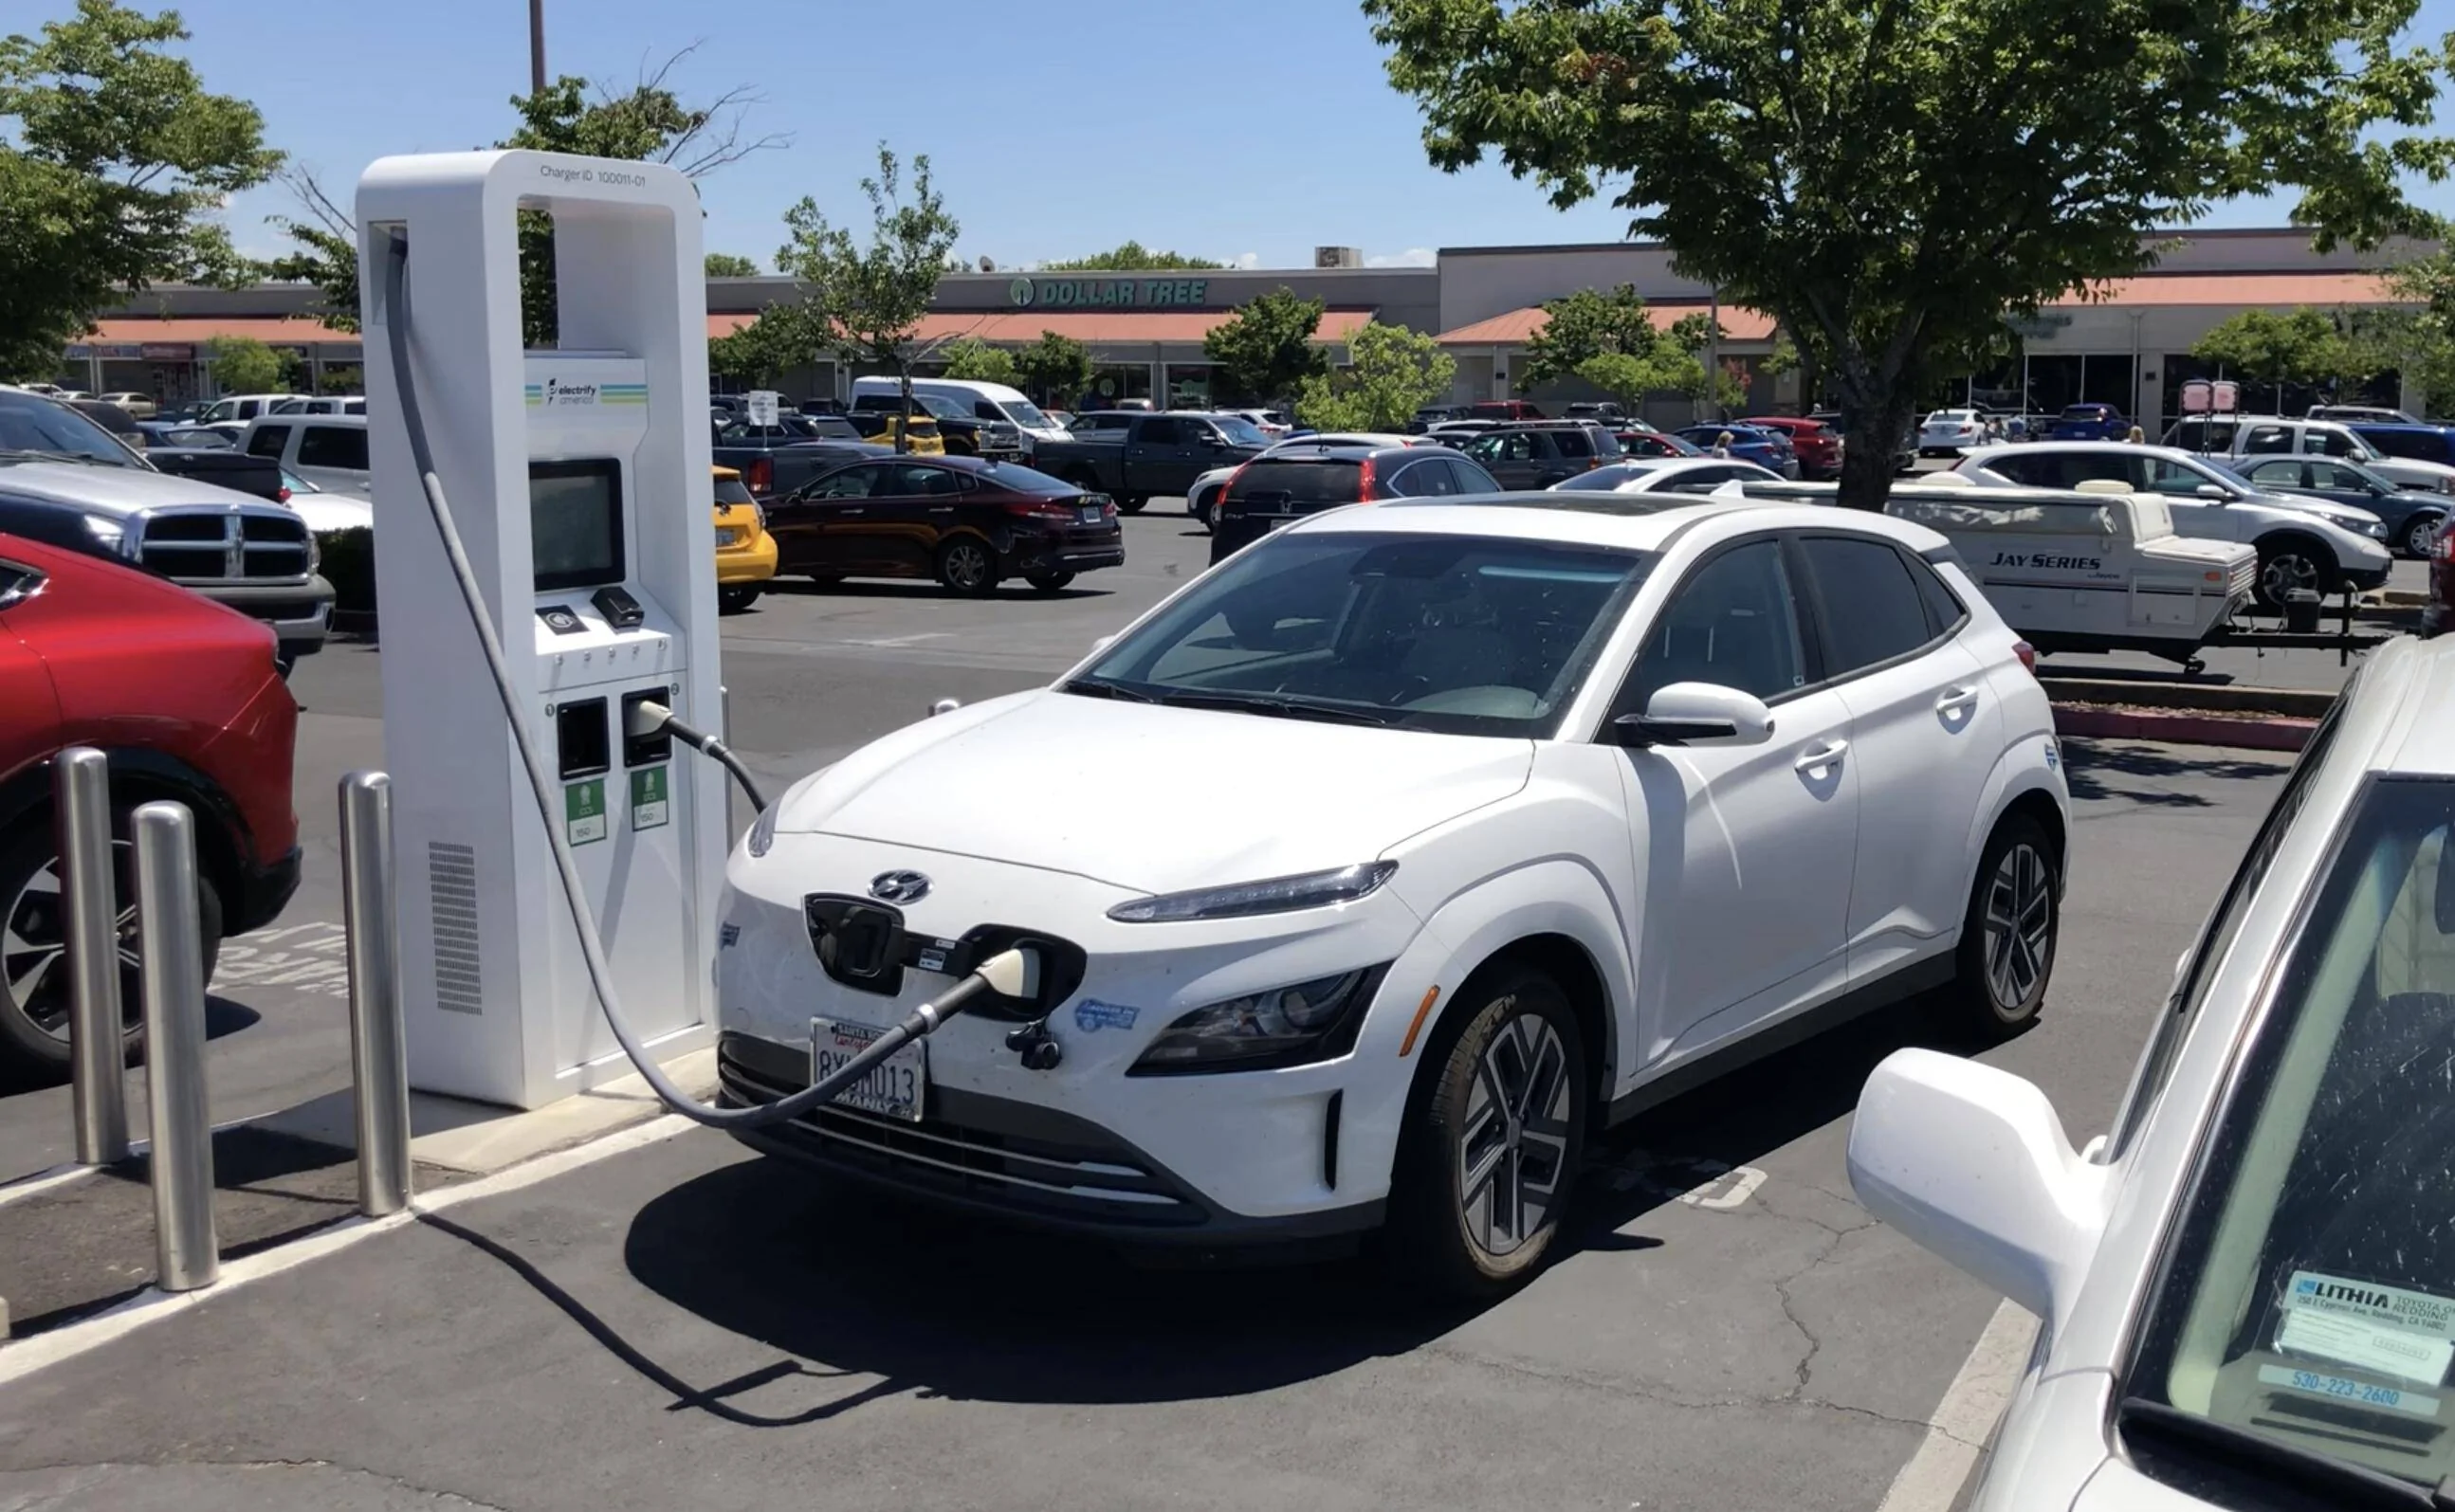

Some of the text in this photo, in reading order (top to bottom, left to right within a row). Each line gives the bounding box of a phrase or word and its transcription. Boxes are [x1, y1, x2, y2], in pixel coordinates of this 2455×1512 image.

[540, 165, 580, 182] Charger
[582, 170, 593, 182] ID
[1044, 279, 1208, 305] DOLLAR TREE
[559, 384, 596, 396] electrify
[1989, 552, 2101, 570] JAY SERIES
[2315, 1283, 2389, 1308] LITHIA
[2396, 1295, 2440, 1313] TOYOTA
[2392, 1303, 2448, 1321] REDDING
[2292, 1371, 2400, 1406] 530-223-2600
